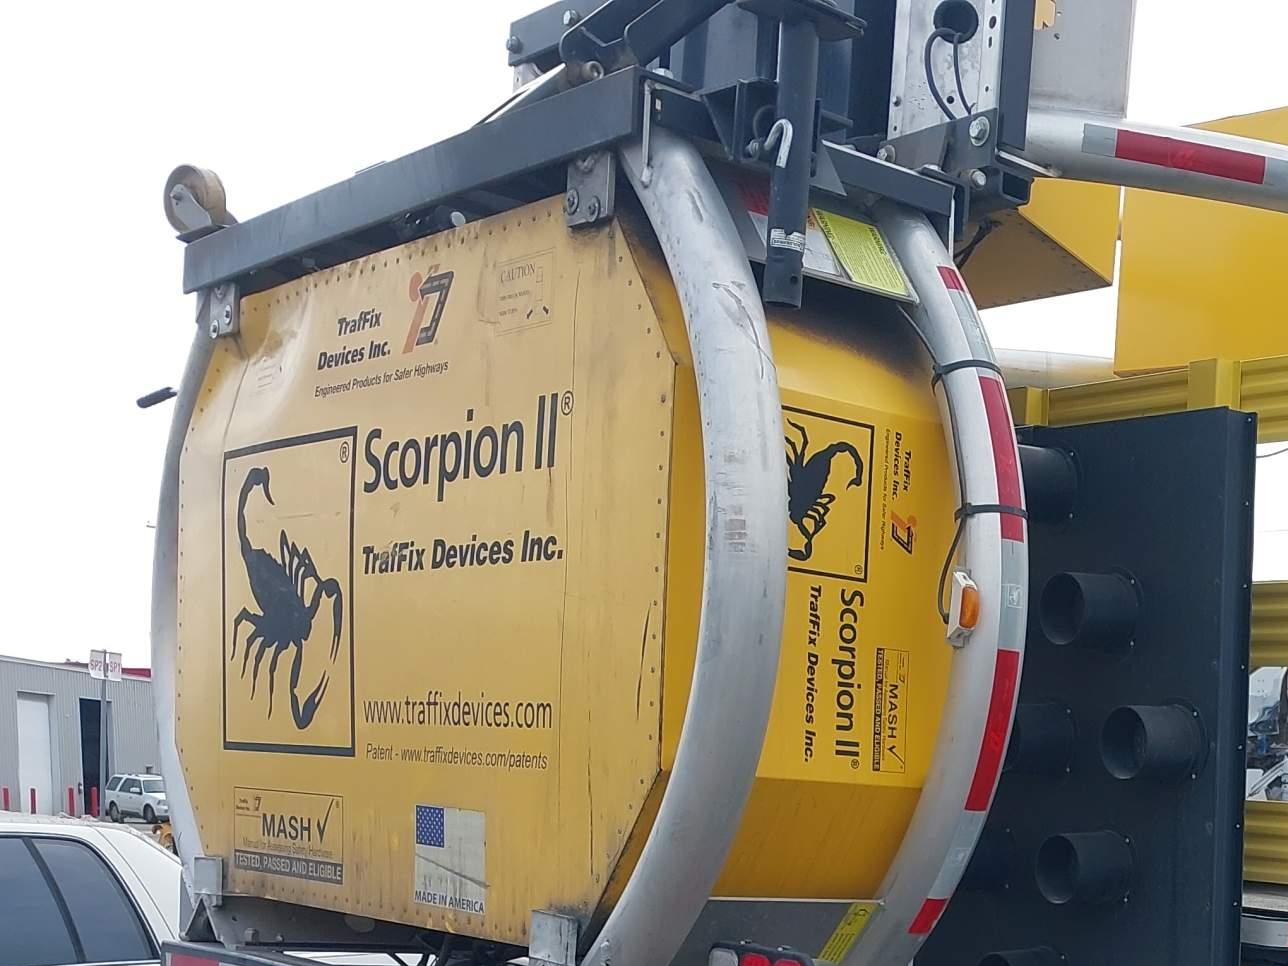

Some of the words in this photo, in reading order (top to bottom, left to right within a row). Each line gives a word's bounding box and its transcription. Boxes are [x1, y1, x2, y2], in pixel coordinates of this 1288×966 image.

[500, 263, 536, 284] CAUTION
[337, 308, 382, 337] TrafFix
[317, 346, 365, 371] Devices
[368, 340, 391, 360] Inc.
[314, 380, 351, 398] Engineered
[351, 374, 382, 390] Products
[383, 371, 393, 384] for
[394, 367, 413, 381] Safer
[414, 360, 449, 379] Highways
[363, 408, 525, 503] Scorpion
[893, 431, 902, 477] Devices
[891, 479, 900, 501] Inc.
[362, 541, 426, 575] TrafFix
[431, 534, 514, 570] Devices
[520, 530, 564, 563] Inc.
[807, 584, 822, 647] TrafFix
[90, 659, 102, 671] SP2
[831, 588, 865, 732] Scorpion
[804, 651, 819, 724] Devices
[363, 690, 553, 729] www.traffixdevices.com
[887, 683, 899, 739] MASH
[366, 743, 393, 761] Patent
[401, 745, 548, 772] www.traffixdevices.com/patents
[803, 729, 816, 763] Inc.
[262, 813, 312, 843] MASH
[235, 853, 262, 869] TESTED,
[263, 855, 291, 873] PASSED
[292, 860, 307, 875] AND
[308, 862, 342, 880] ELIGIBLE
[414, 890, 437, 905] MADE
[438, 894, 447, 906] IN
[448, 896, 485, 914] AMERICA
